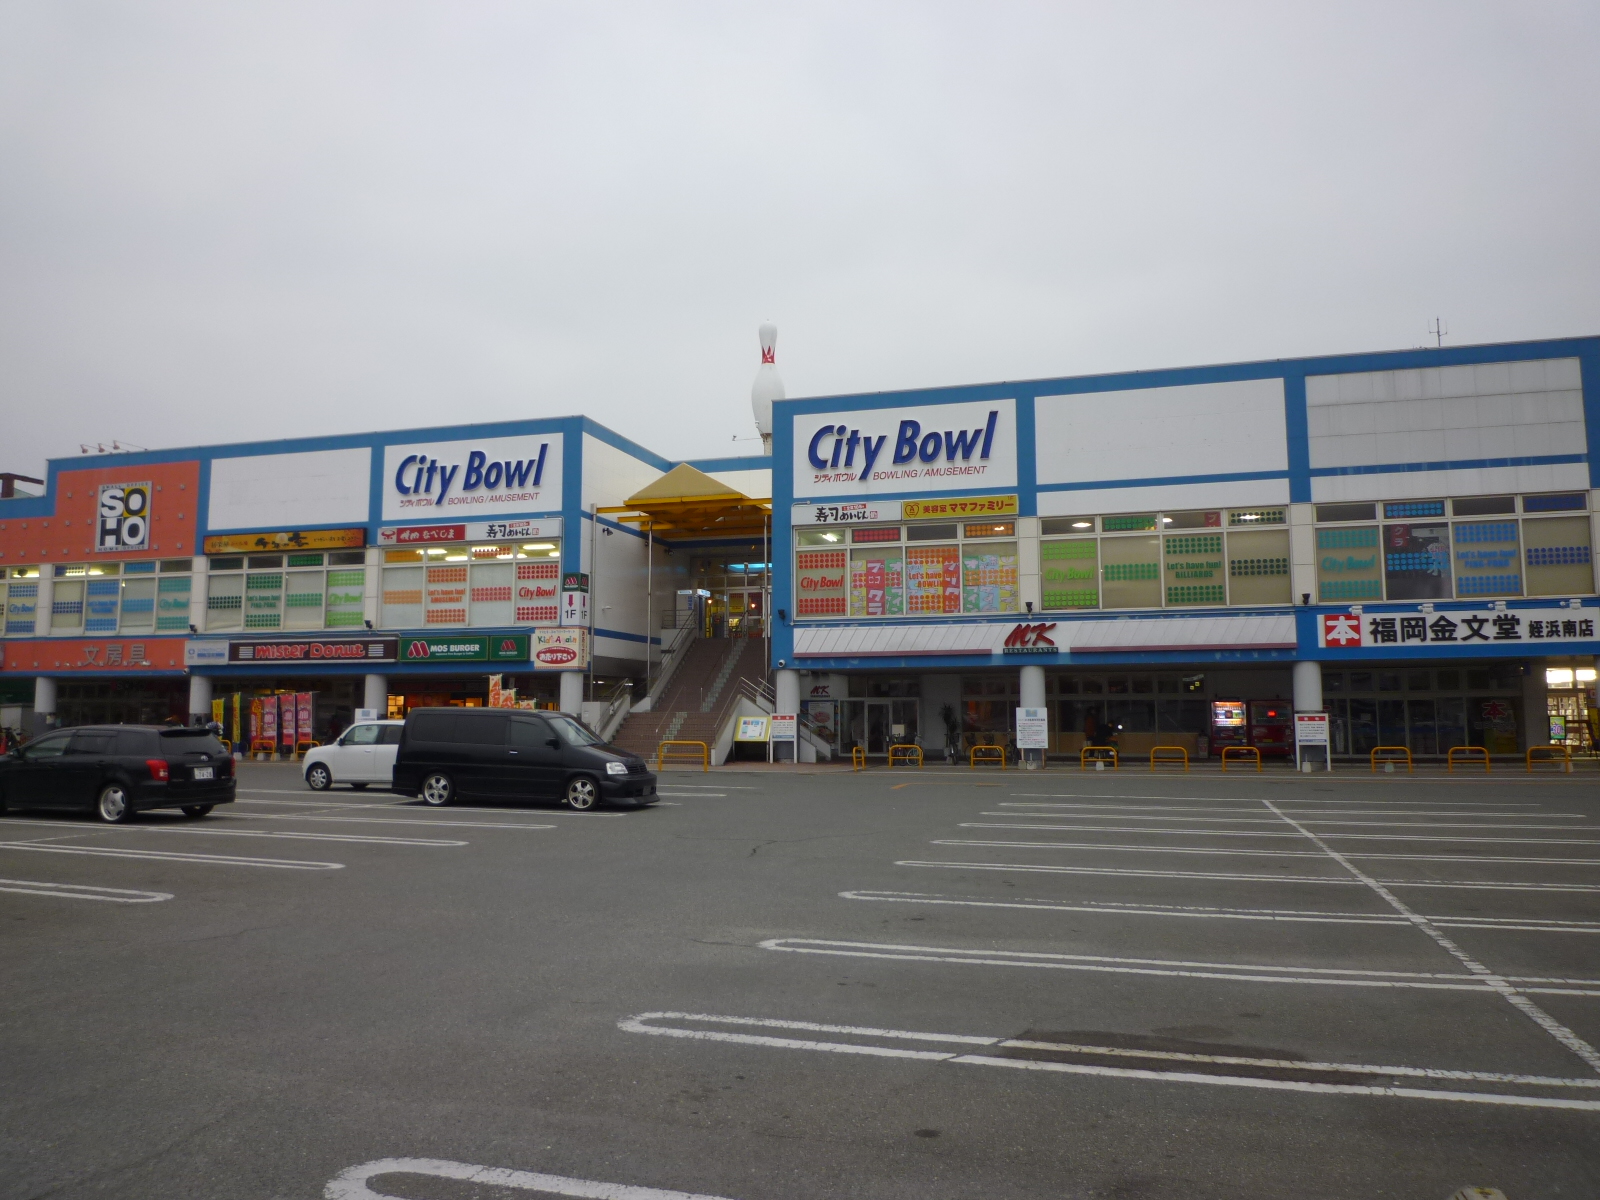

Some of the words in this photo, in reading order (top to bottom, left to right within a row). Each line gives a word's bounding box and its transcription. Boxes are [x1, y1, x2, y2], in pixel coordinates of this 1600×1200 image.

[808, 424, 887, 480] City
[893, 410, 999, 464] Bowl
[395, 454, 459, 505] City
[462, 443, 549, 491] Bowl
[814, 472, 857, 483] シティボウル
[873, 469, 918, 481] BOWLING
[924, 465, 987, 477] AMUSEMENT
[448, 495, 484, 506] BOWLING
[489, 492, 540, 503] AMUSEMENT
[949, 500, 1014, 513] ママファミリー
[1045, 567, 1067, 582] City
[1067, 565, 1095, 580] Bowl
[1167, 562, 1184, 570] Let's
[1186, 561, 1204, 569] have
[909, 571, 924, 580] Let's
[926, 570, 942, 580] have
[1175, 570, 1213, 579] BILLIARDS
[801, 576, 819, 591] City
[820, 575, 844, 588] Bowl
[519, 586, 535, 600] City
[536, 585, 557, 597] Bowl
[564, 609, 576, 619] 1F
[581, 610, 588, 620] 1F
[1004, 622, 1057, 647] MK
[1326, 615, 1360, 645] 本
[1369, 614, 1522, 644] 福岡金文堂
[1528, 619, 1594, 638] 姪浜南店
[83, 644, 147, 667] 文房具
[309, 642, 366, 658] Donut
[430, 644, 448, 652] MOS
[449, 643, 480, 652] BURGER
[1482, 701, 1507, 720] 本
